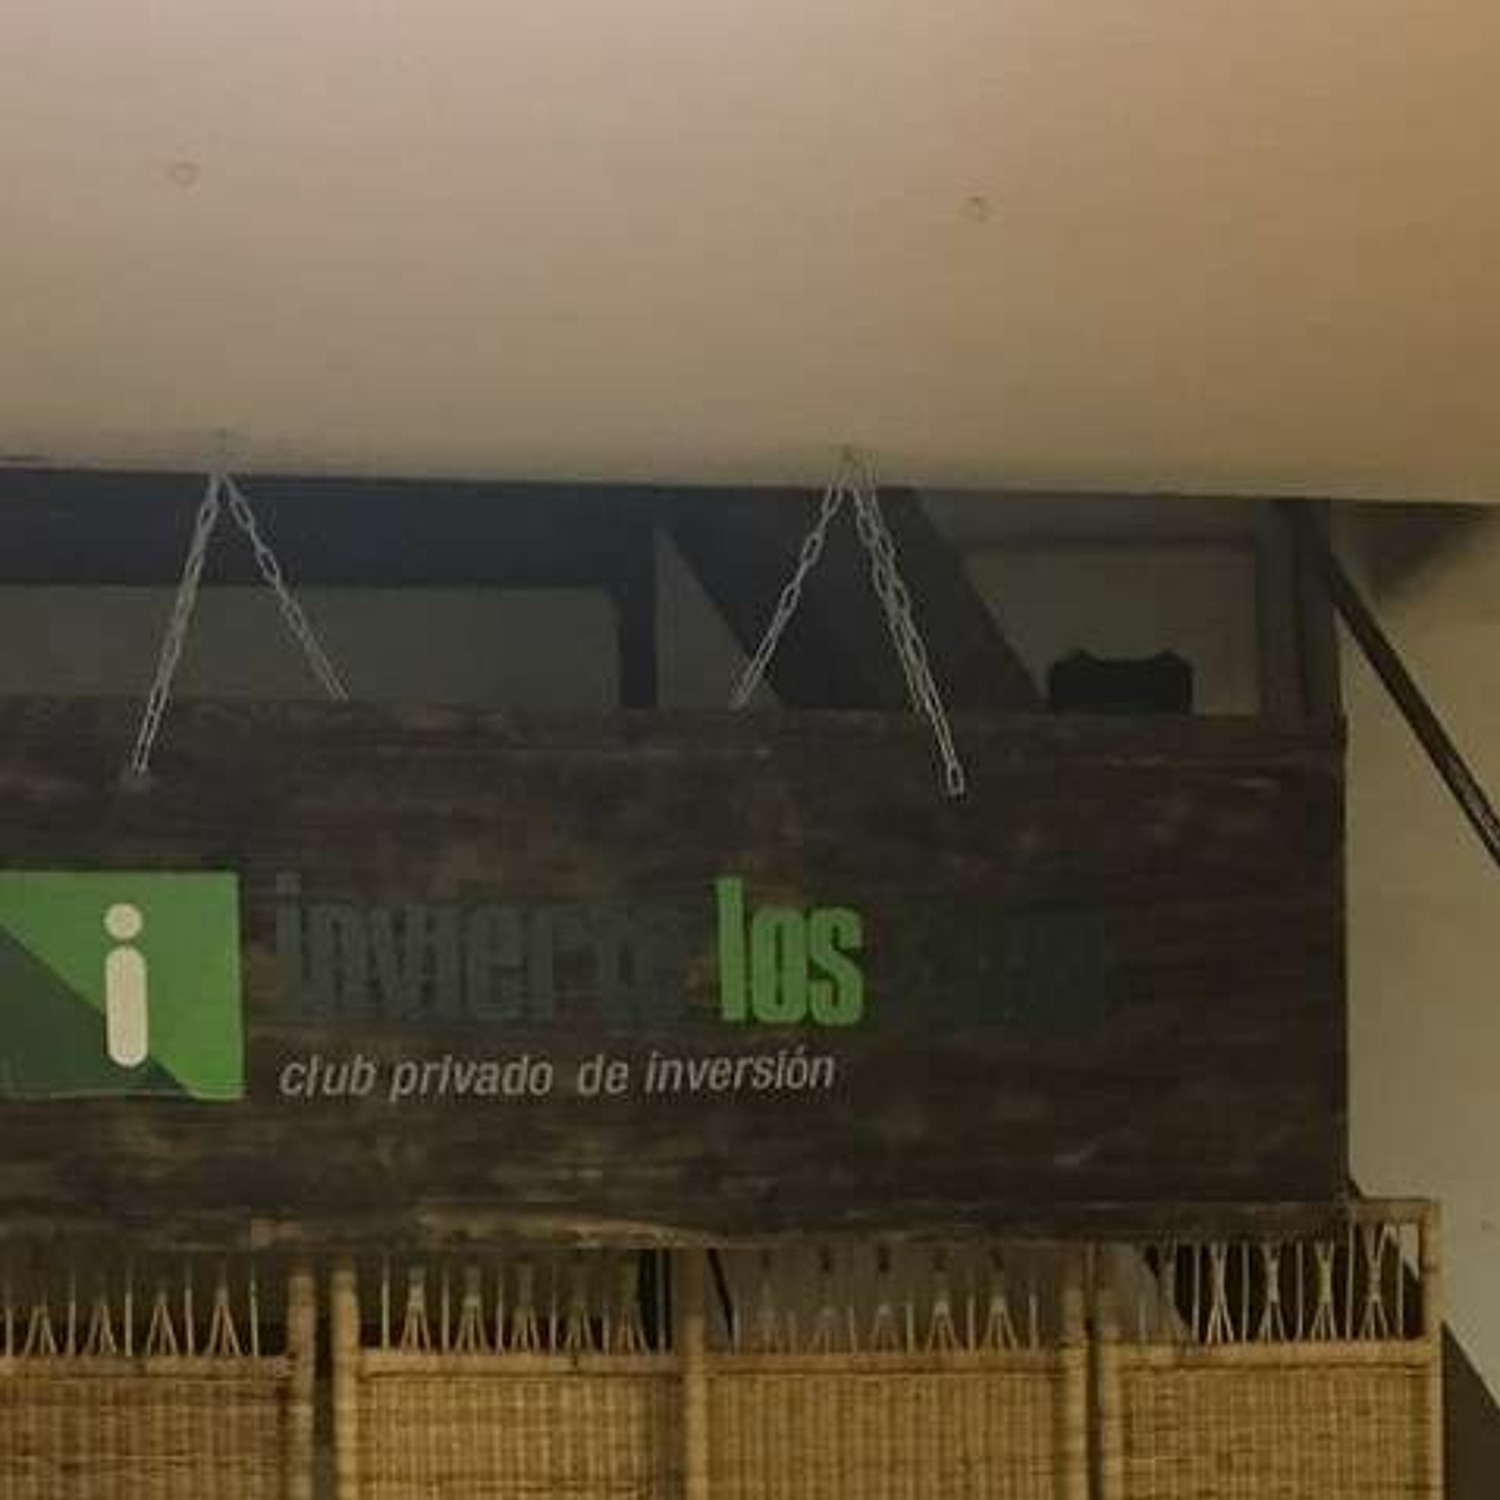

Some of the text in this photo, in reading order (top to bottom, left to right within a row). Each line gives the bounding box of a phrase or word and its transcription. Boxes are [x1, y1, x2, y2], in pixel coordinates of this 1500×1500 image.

[278, 1044, 836, 1103] club privado de inversión
